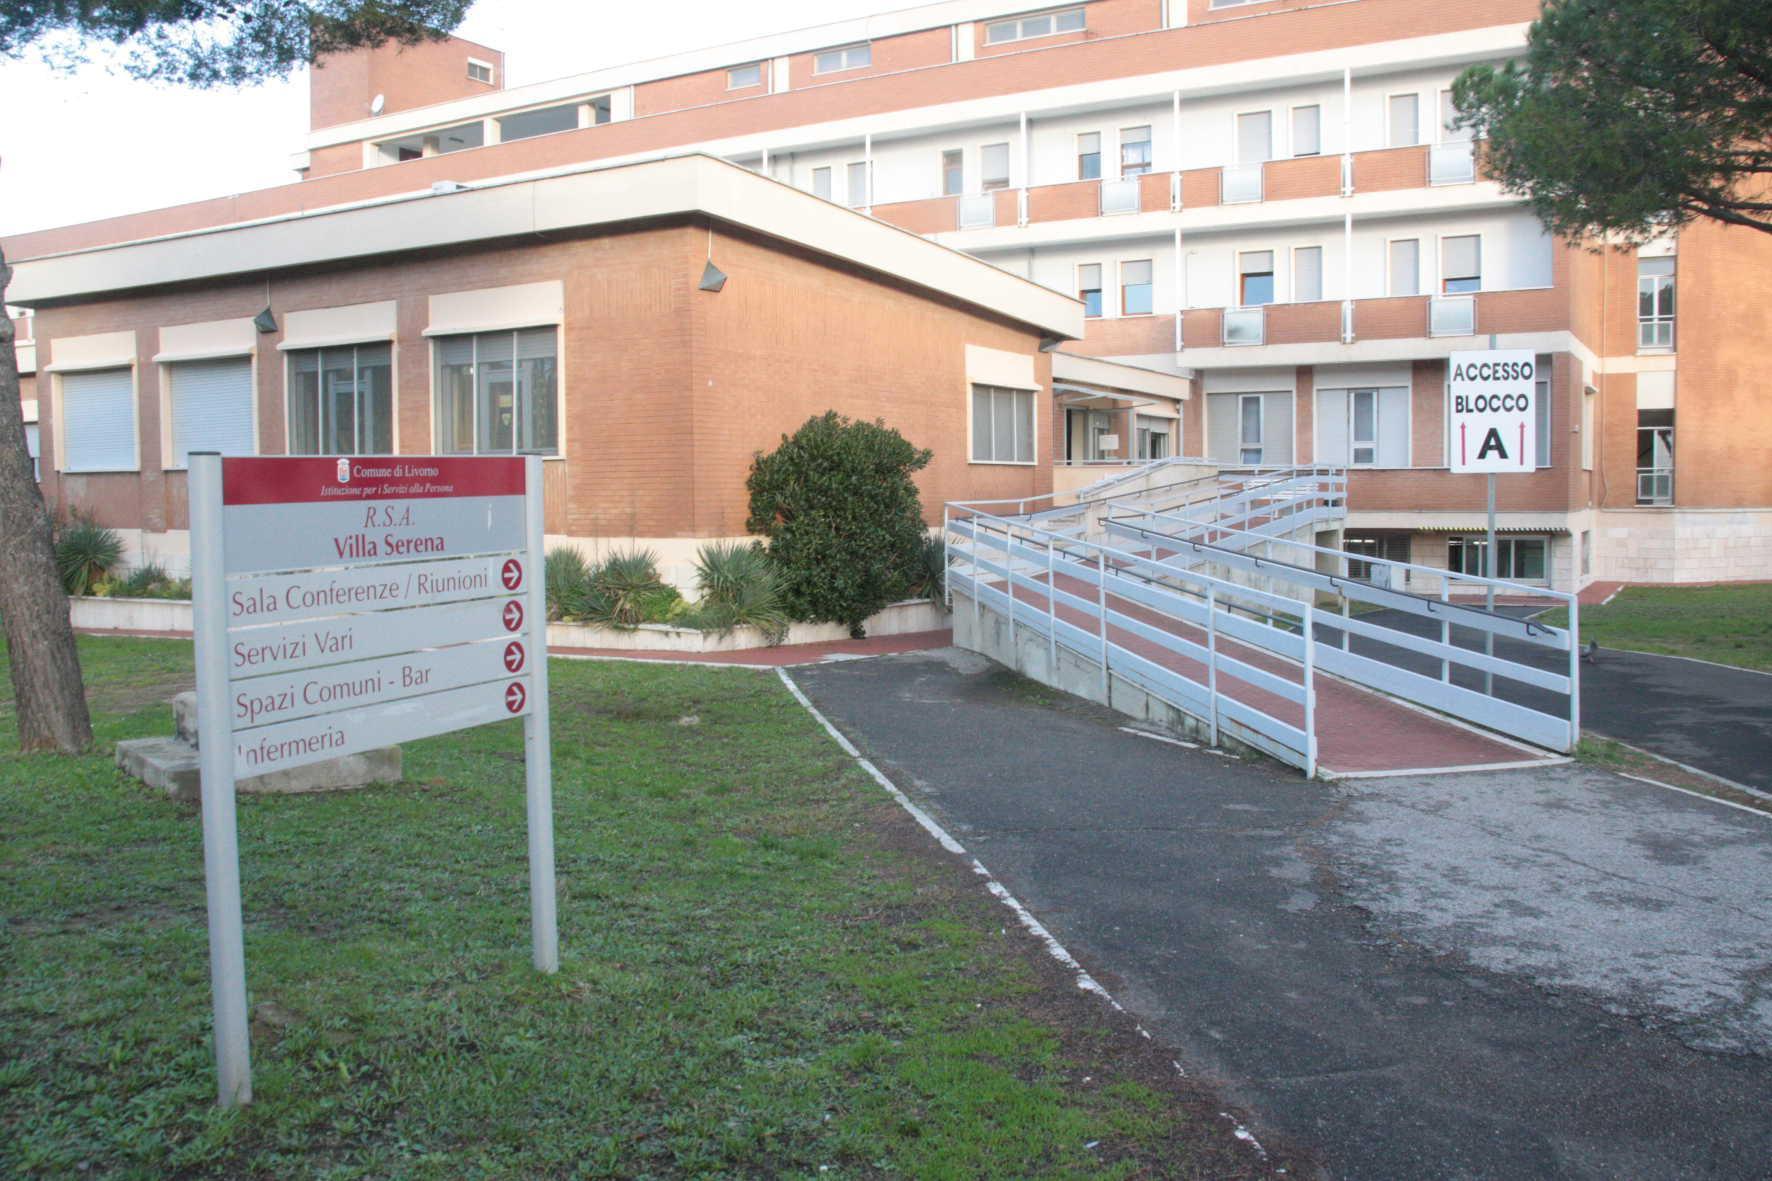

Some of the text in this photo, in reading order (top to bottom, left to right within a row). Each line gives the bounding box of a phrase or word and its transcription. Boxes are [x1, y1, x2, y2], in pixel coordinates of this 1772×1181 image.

[1453, 362, 1533, 381] ACCESSO
[1455, 394, 1529, 413] BLOCCO
[1477, 428, 1508, 459] A
[353, 463, 439, 478] Comune di Livorno
[363, 485, 377, 497] per
[382, 483, 408, 494] Servizi
[409, 483, 425, 493] alla
[425, 482, 454, 493] Persona
[363, 505, 415, 528] R.S.A.
[334, 533, 445, 559] Villa Serena
[232, 584, 277, 617] Sala
[234, 628, 353, 668] Servizi Vari
[236, 686, 295, 722] Spazi
[303, 671, 382, 704] Comuni
[402, 666, 431, 688] Bar
